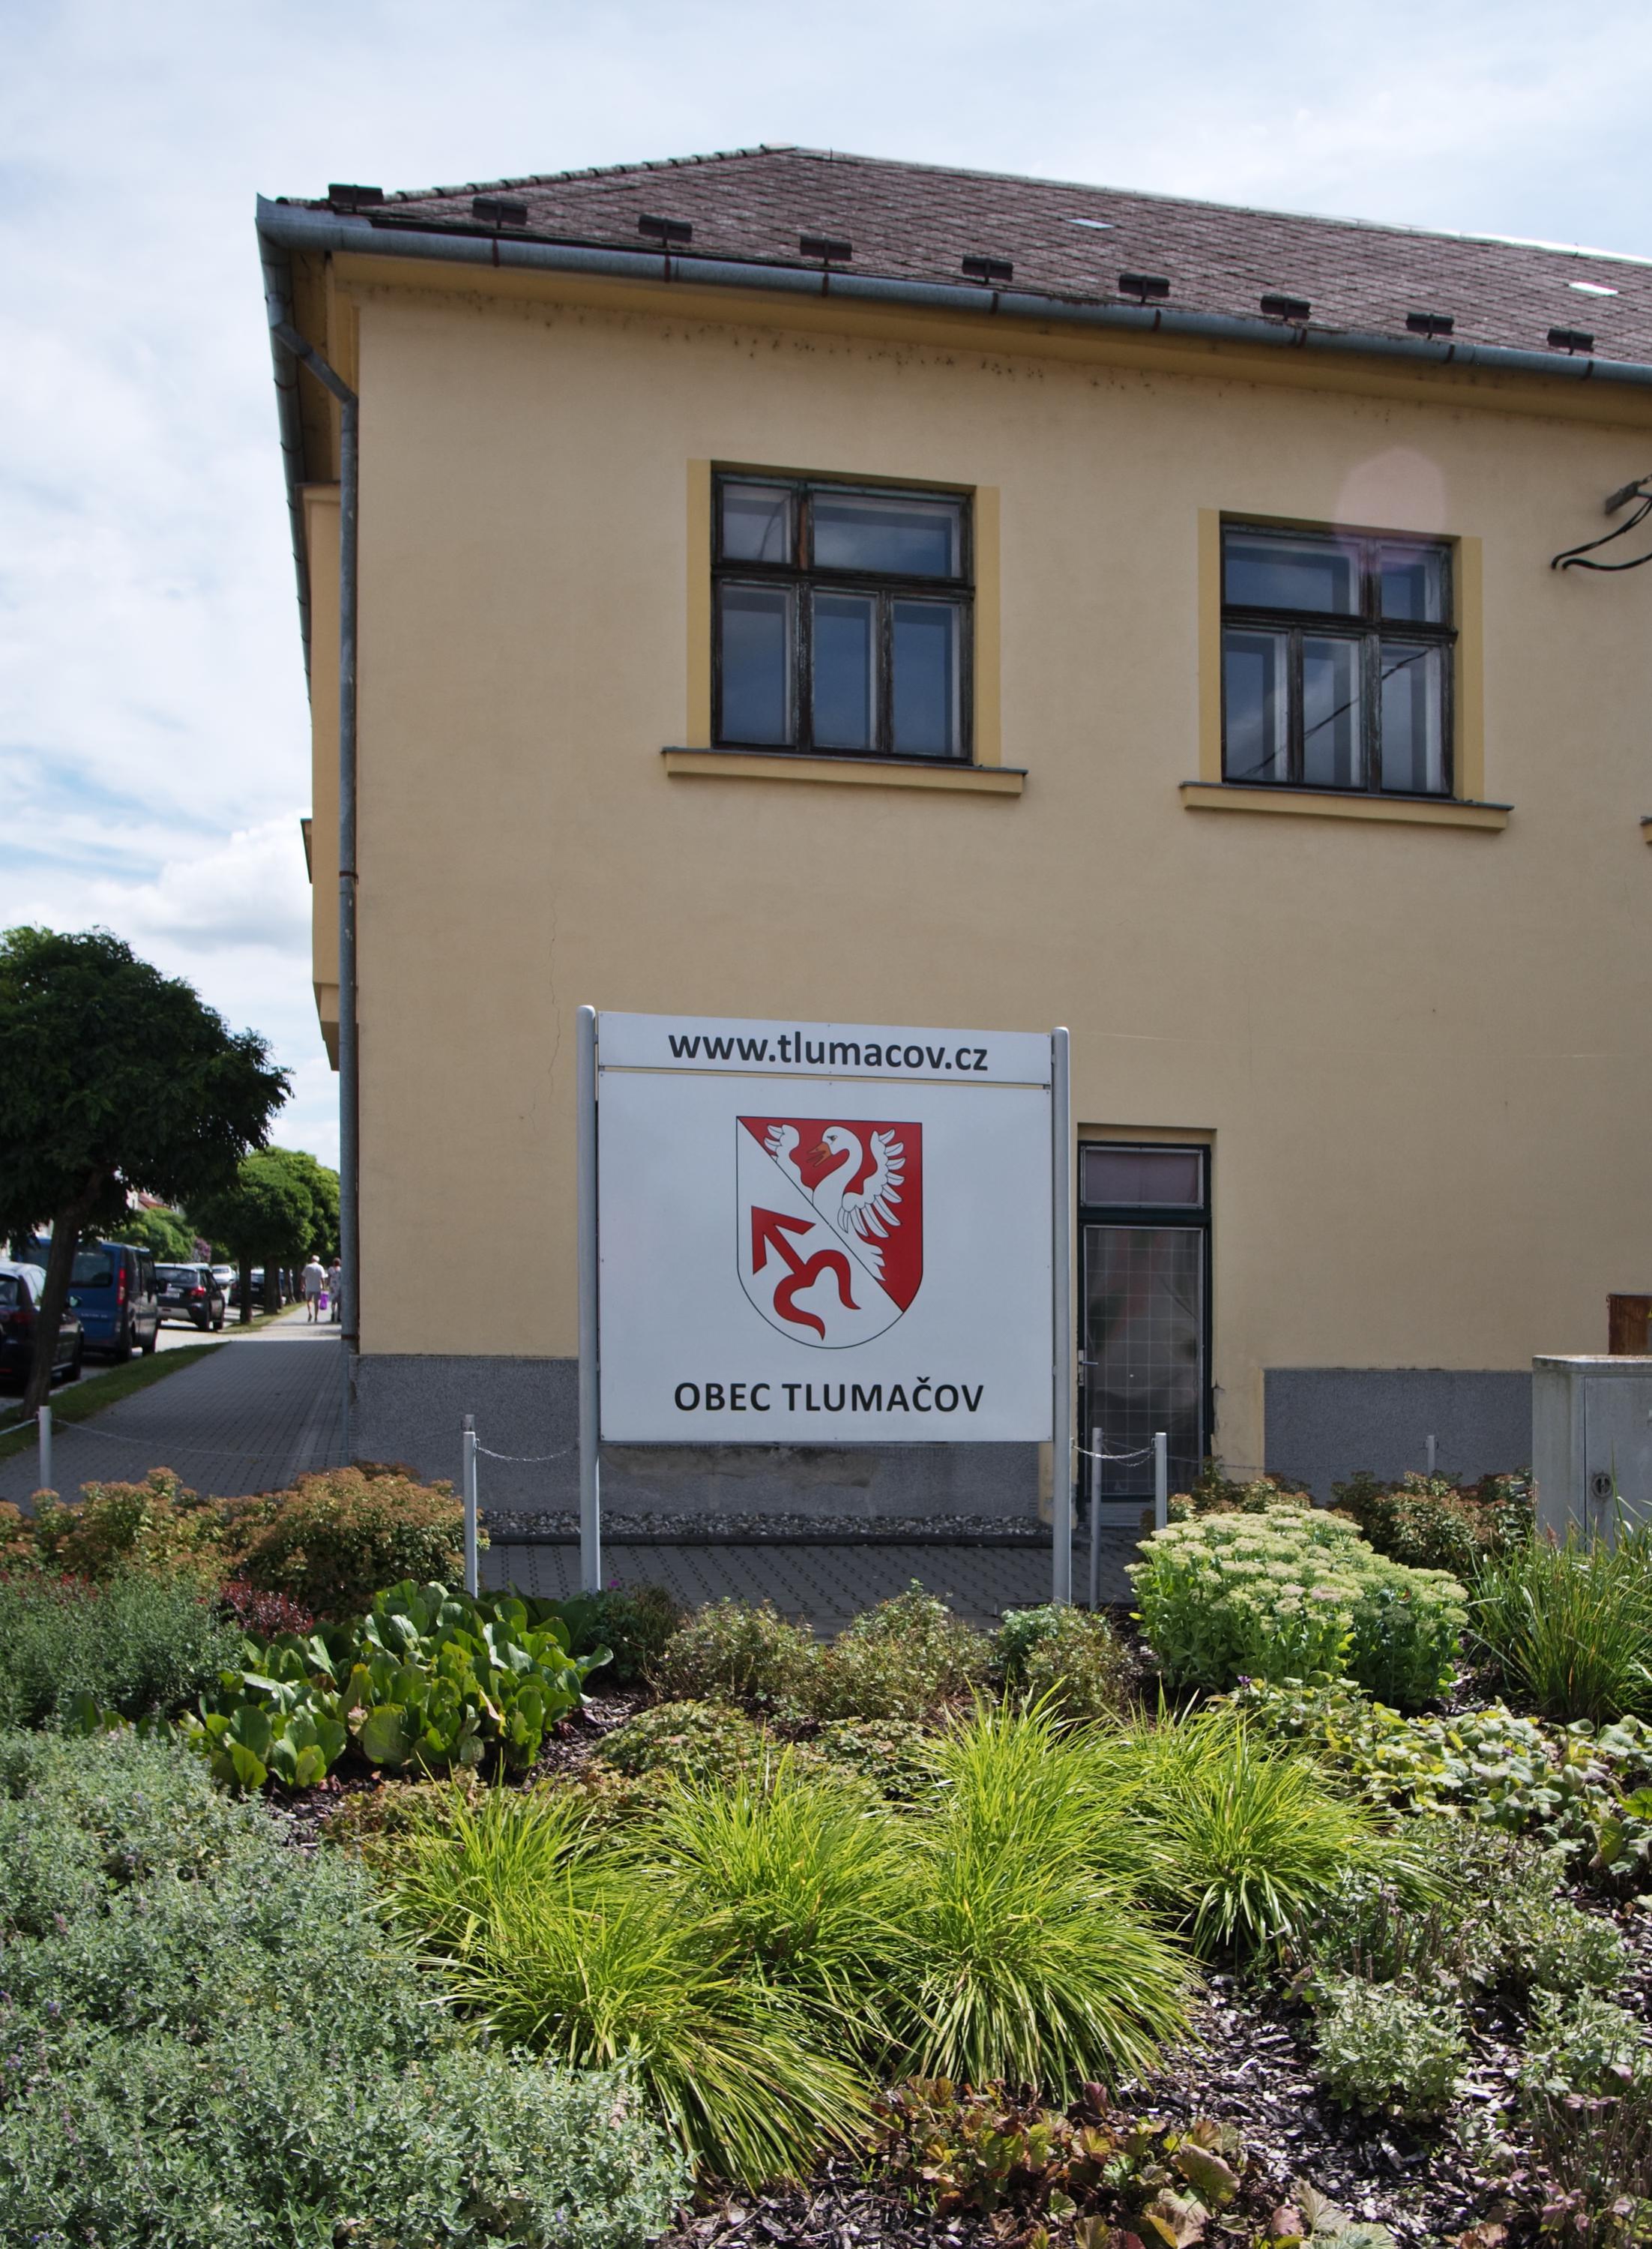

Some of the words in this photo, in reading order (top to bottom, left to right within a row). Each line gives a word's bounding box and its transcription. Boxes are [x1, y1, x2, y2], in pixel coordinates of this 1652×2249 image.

[668, 1031, 989, 1072] www.tlumacov.cz
[674, 1382, 771, 1412] OBEC
[781, 1376, 984, 1412] TLUMAČOV
